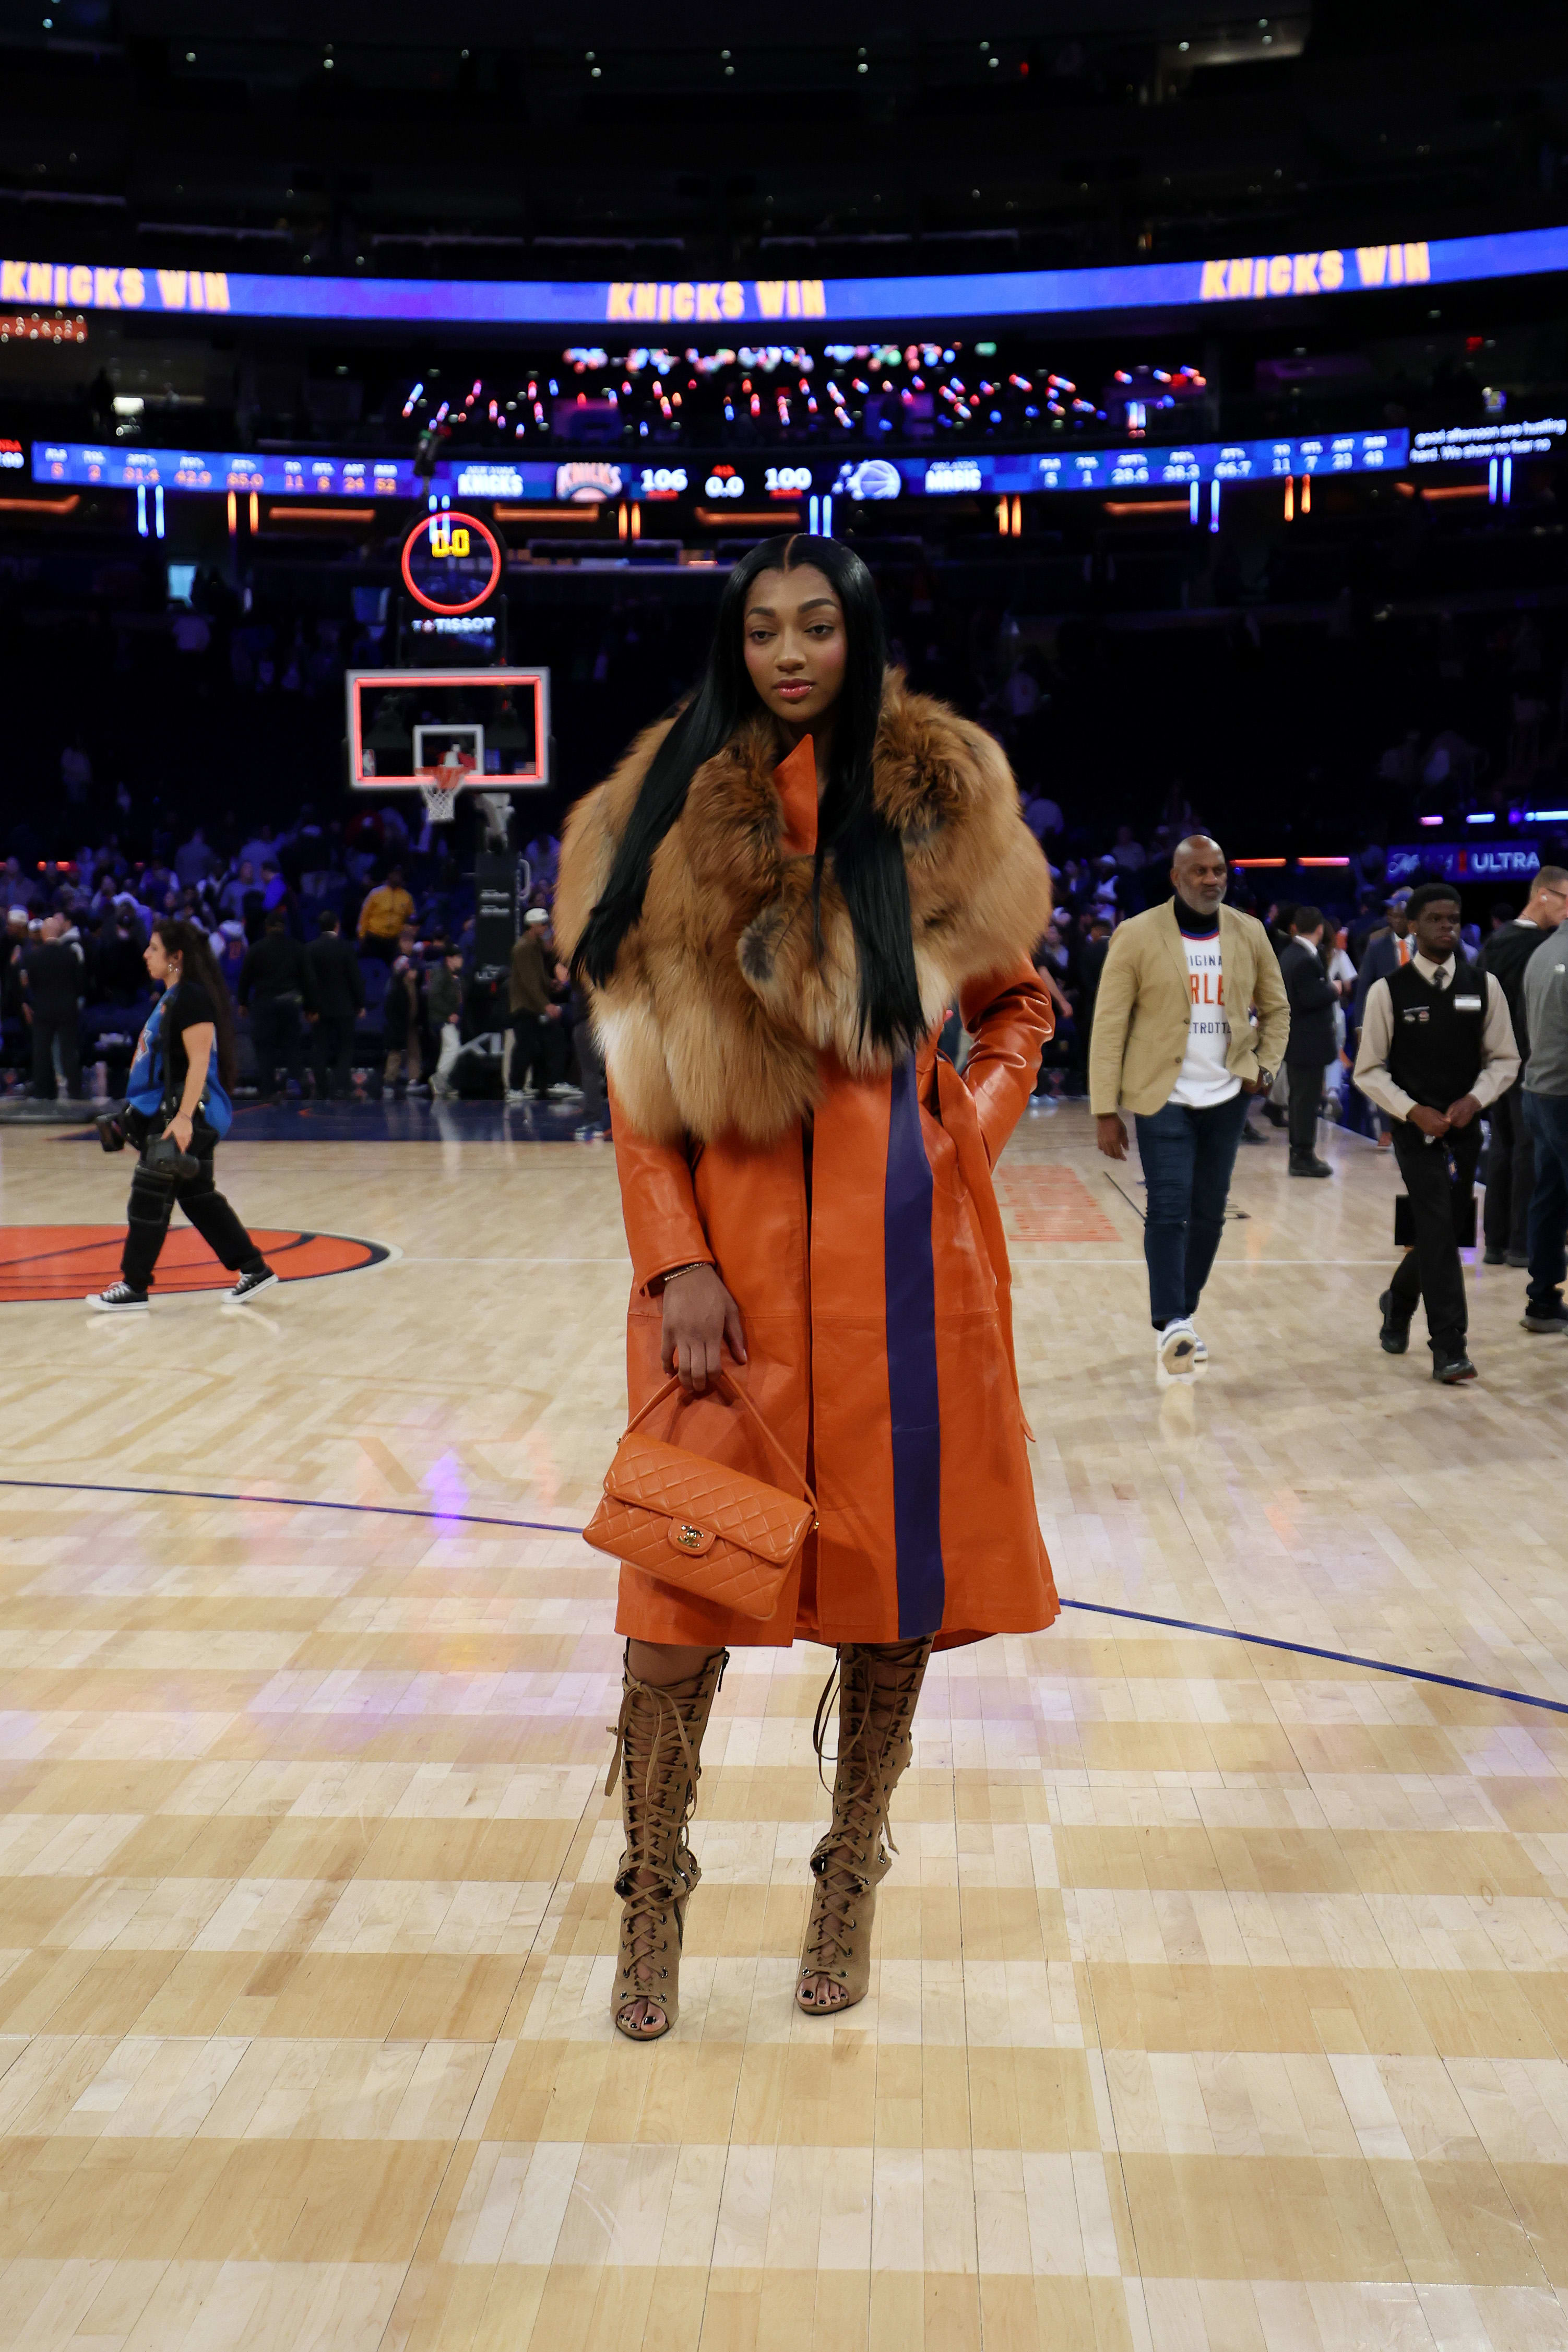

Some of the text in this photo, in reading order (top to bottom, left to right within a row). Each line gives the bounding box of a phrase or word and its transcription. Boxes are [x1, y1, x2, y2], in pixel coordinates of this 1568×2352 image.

[1199, 241, 1431, 301] KNICKS WIN
[1, 260, 230, 311] KNICKS WIN
[607, 280, 826, 322] KNICKS WIN
[640, 469, 688, 491] 106
[705, 476, 744, 498] 0.0
[764, 468, 812, 491] 100
[925, 469, 981, 493] MAGIC
[431, 529, 470, 557] 0.0
[434, 617, 496, 634] TISSOT
[1471, 851, 1540, 874] ULTRA
